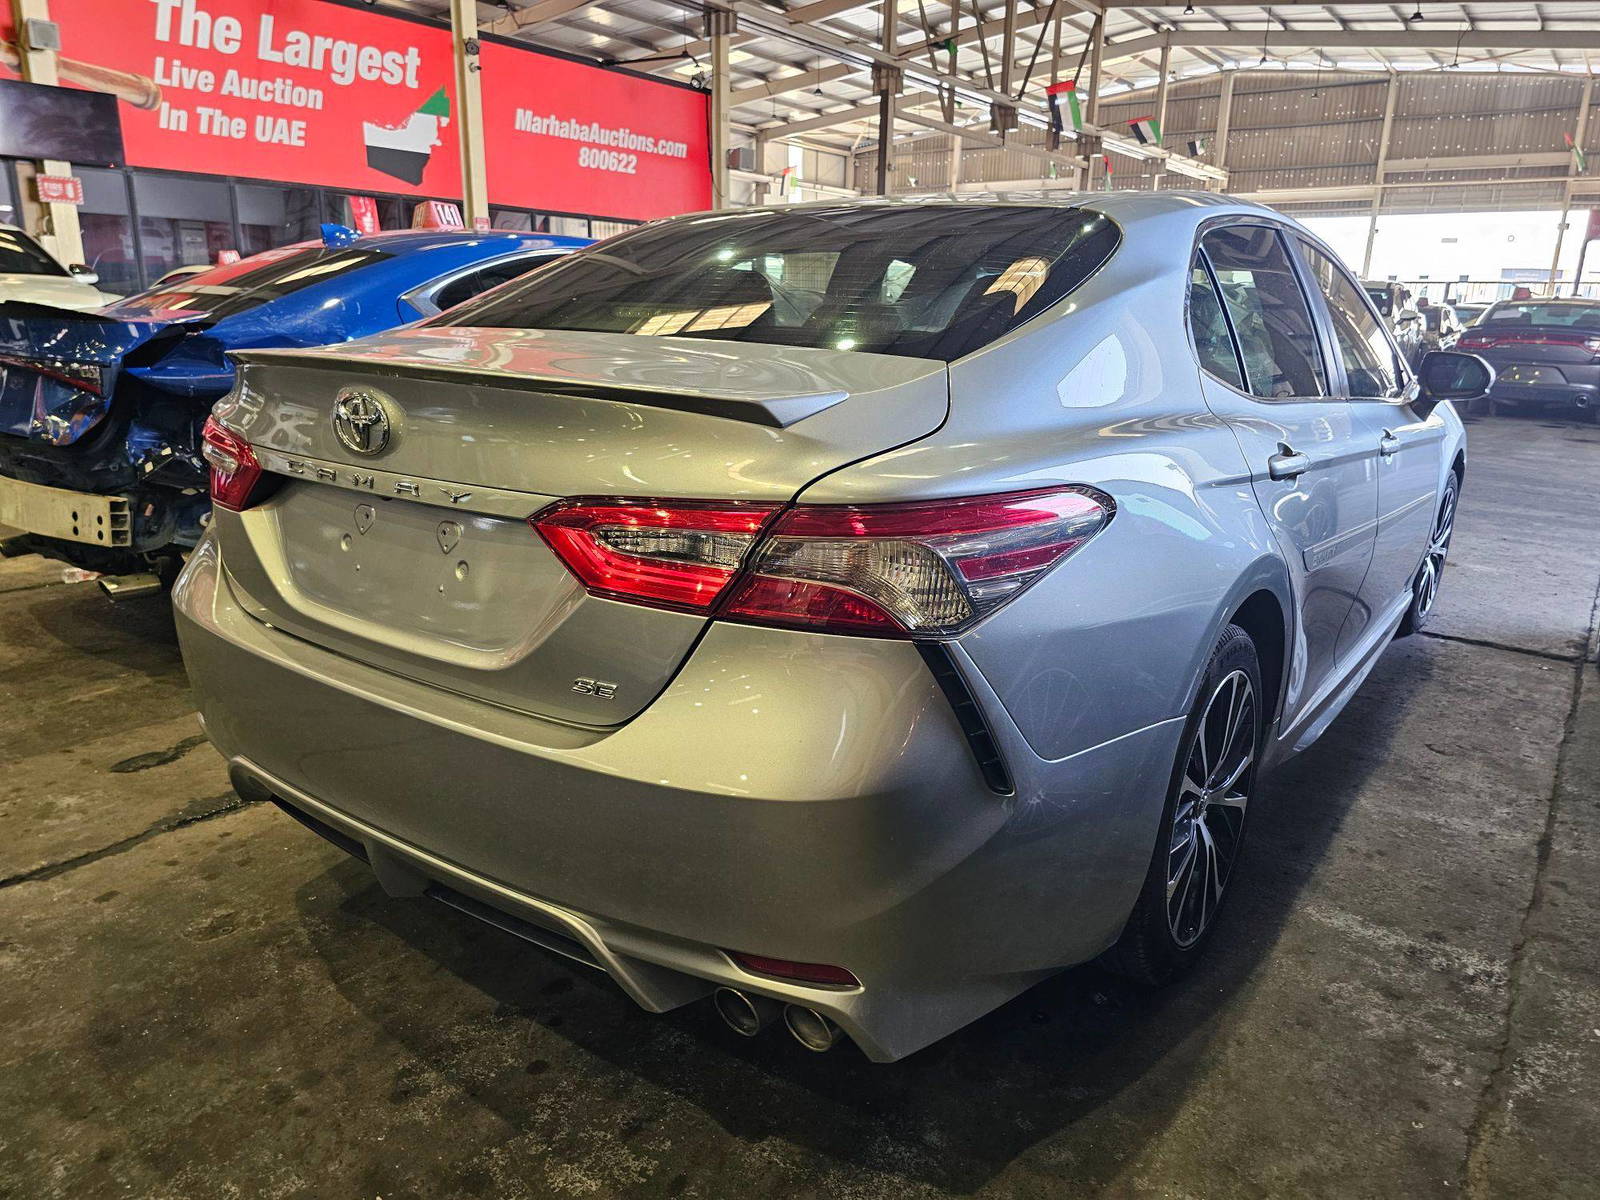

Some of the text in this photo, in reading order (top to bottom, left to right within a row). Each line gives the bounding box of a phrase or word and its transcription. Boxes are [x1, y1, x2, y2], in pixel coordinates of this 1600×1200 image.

[151, 0, 421, 89] The Largest
[154, 57, 323, 110] Live Auction
[159, 102, 307, 147] In The UAE
[514, 108, 688, 159] MarhabaAuctions.com
[578, 147, 638, 174] 800622
[434, 203, 461, 226] 141
[287, 460, 473, 504] CAMRY
[571, 677, 618, 700] SE
